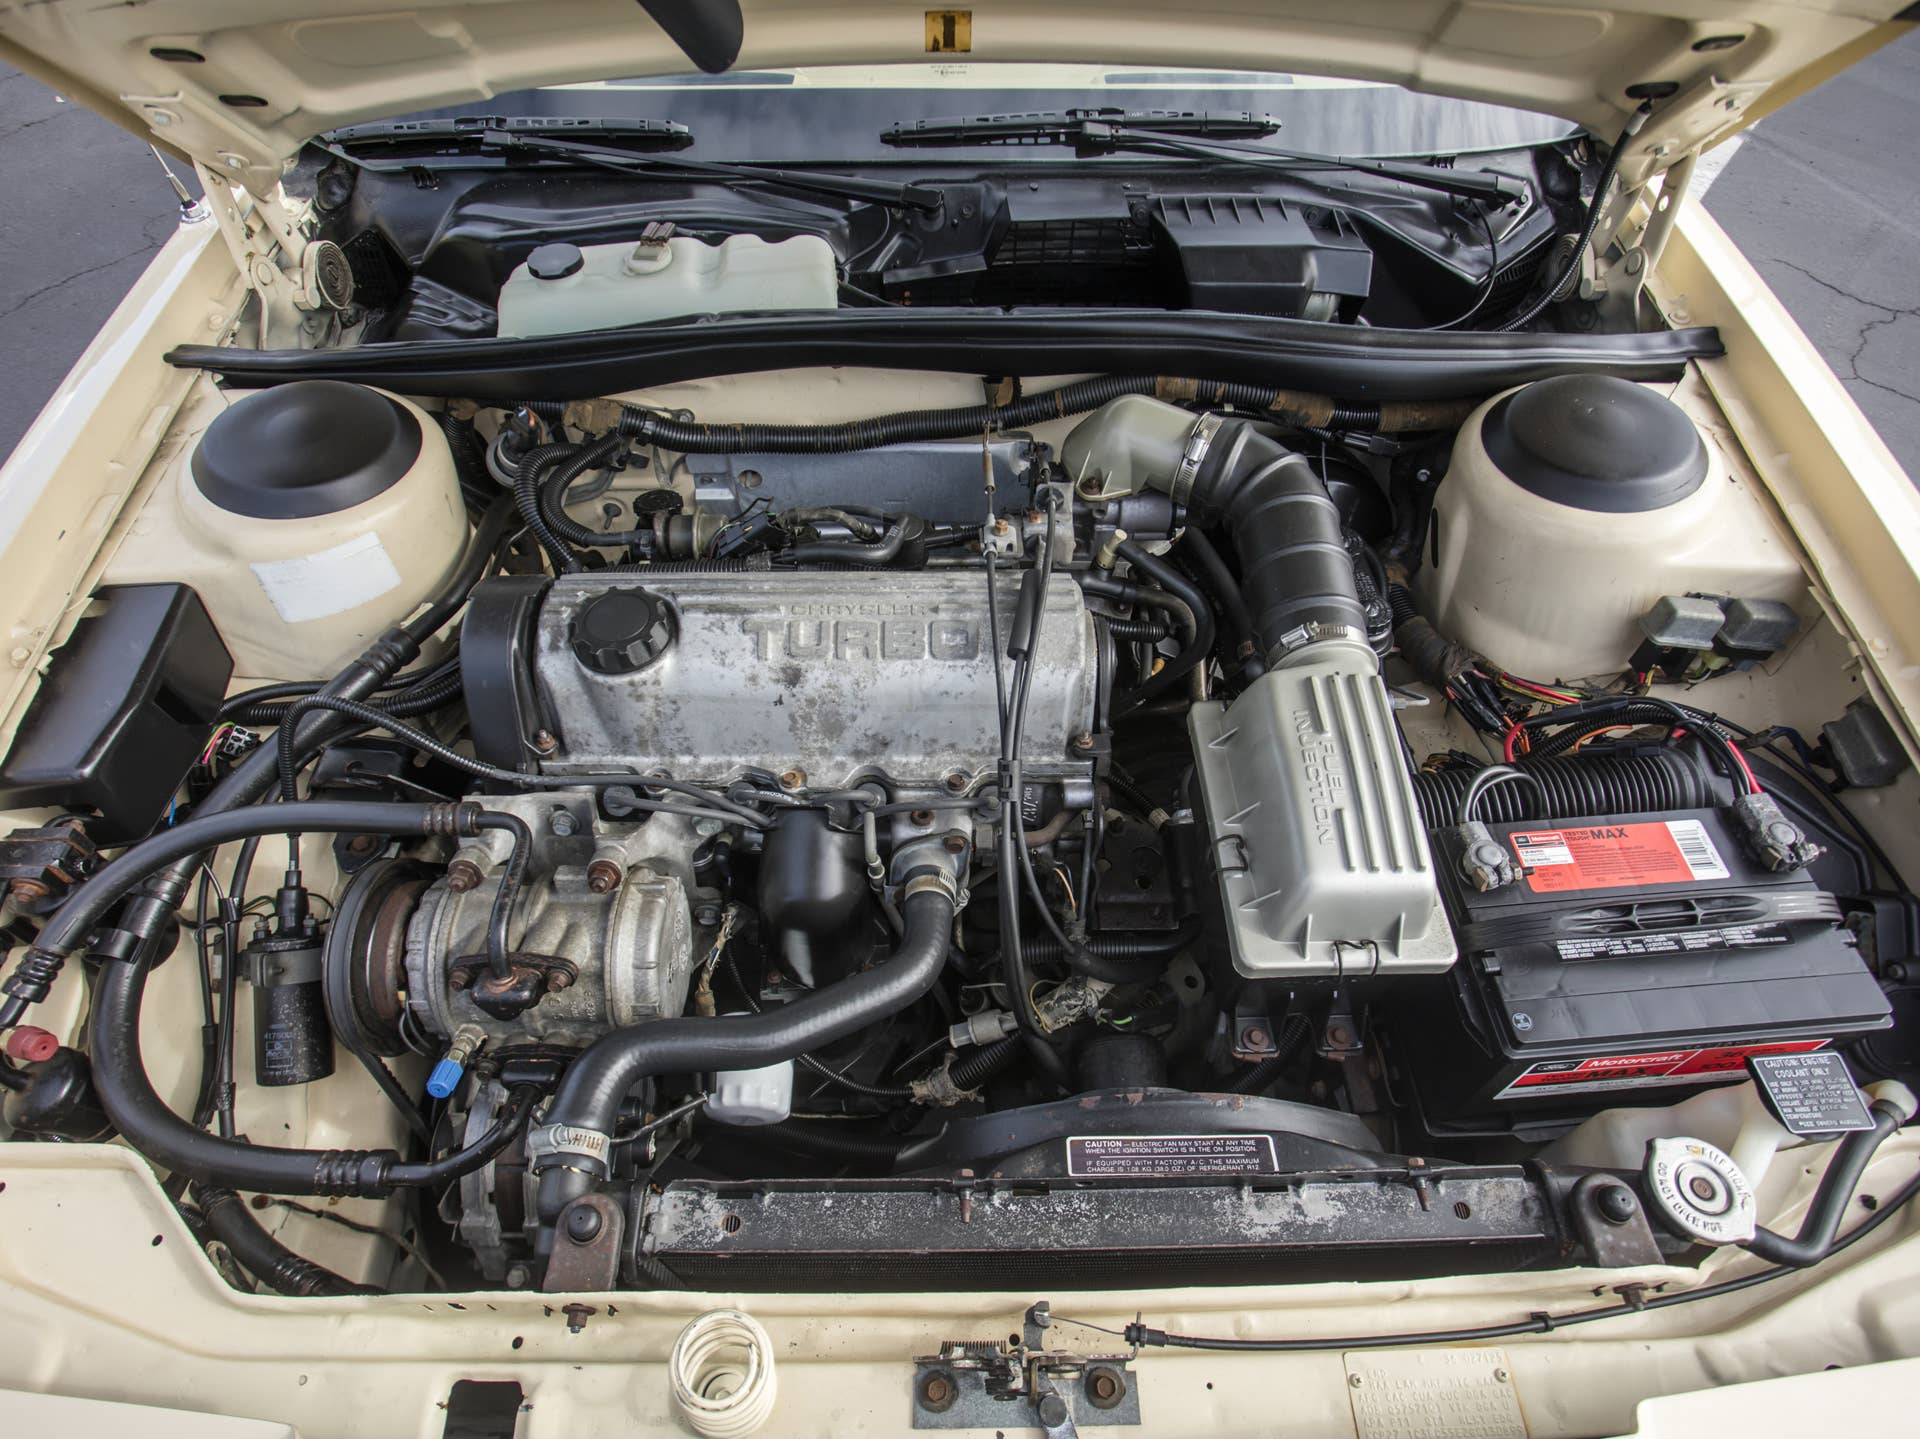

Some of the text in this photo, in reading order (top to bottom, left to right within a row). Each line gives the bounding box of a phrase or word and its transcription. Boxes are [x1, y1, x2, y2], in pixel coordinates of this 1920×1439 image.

[790, 603, 930, 616] CHRYSLER
[741, 619, 980, 661] TURBO
[1293, 710, 1335, 845] INJECTION
[1319, 738, 1345, 804] FUEL
[1590, 827, 1629, 841] MAX
[1589, 1054, 1683, 1067] Motorcraft
[1801, 1056, 1830, 1066] ENGINE
[1774, 1067, 1830, 1078] COOLANT ONLY
